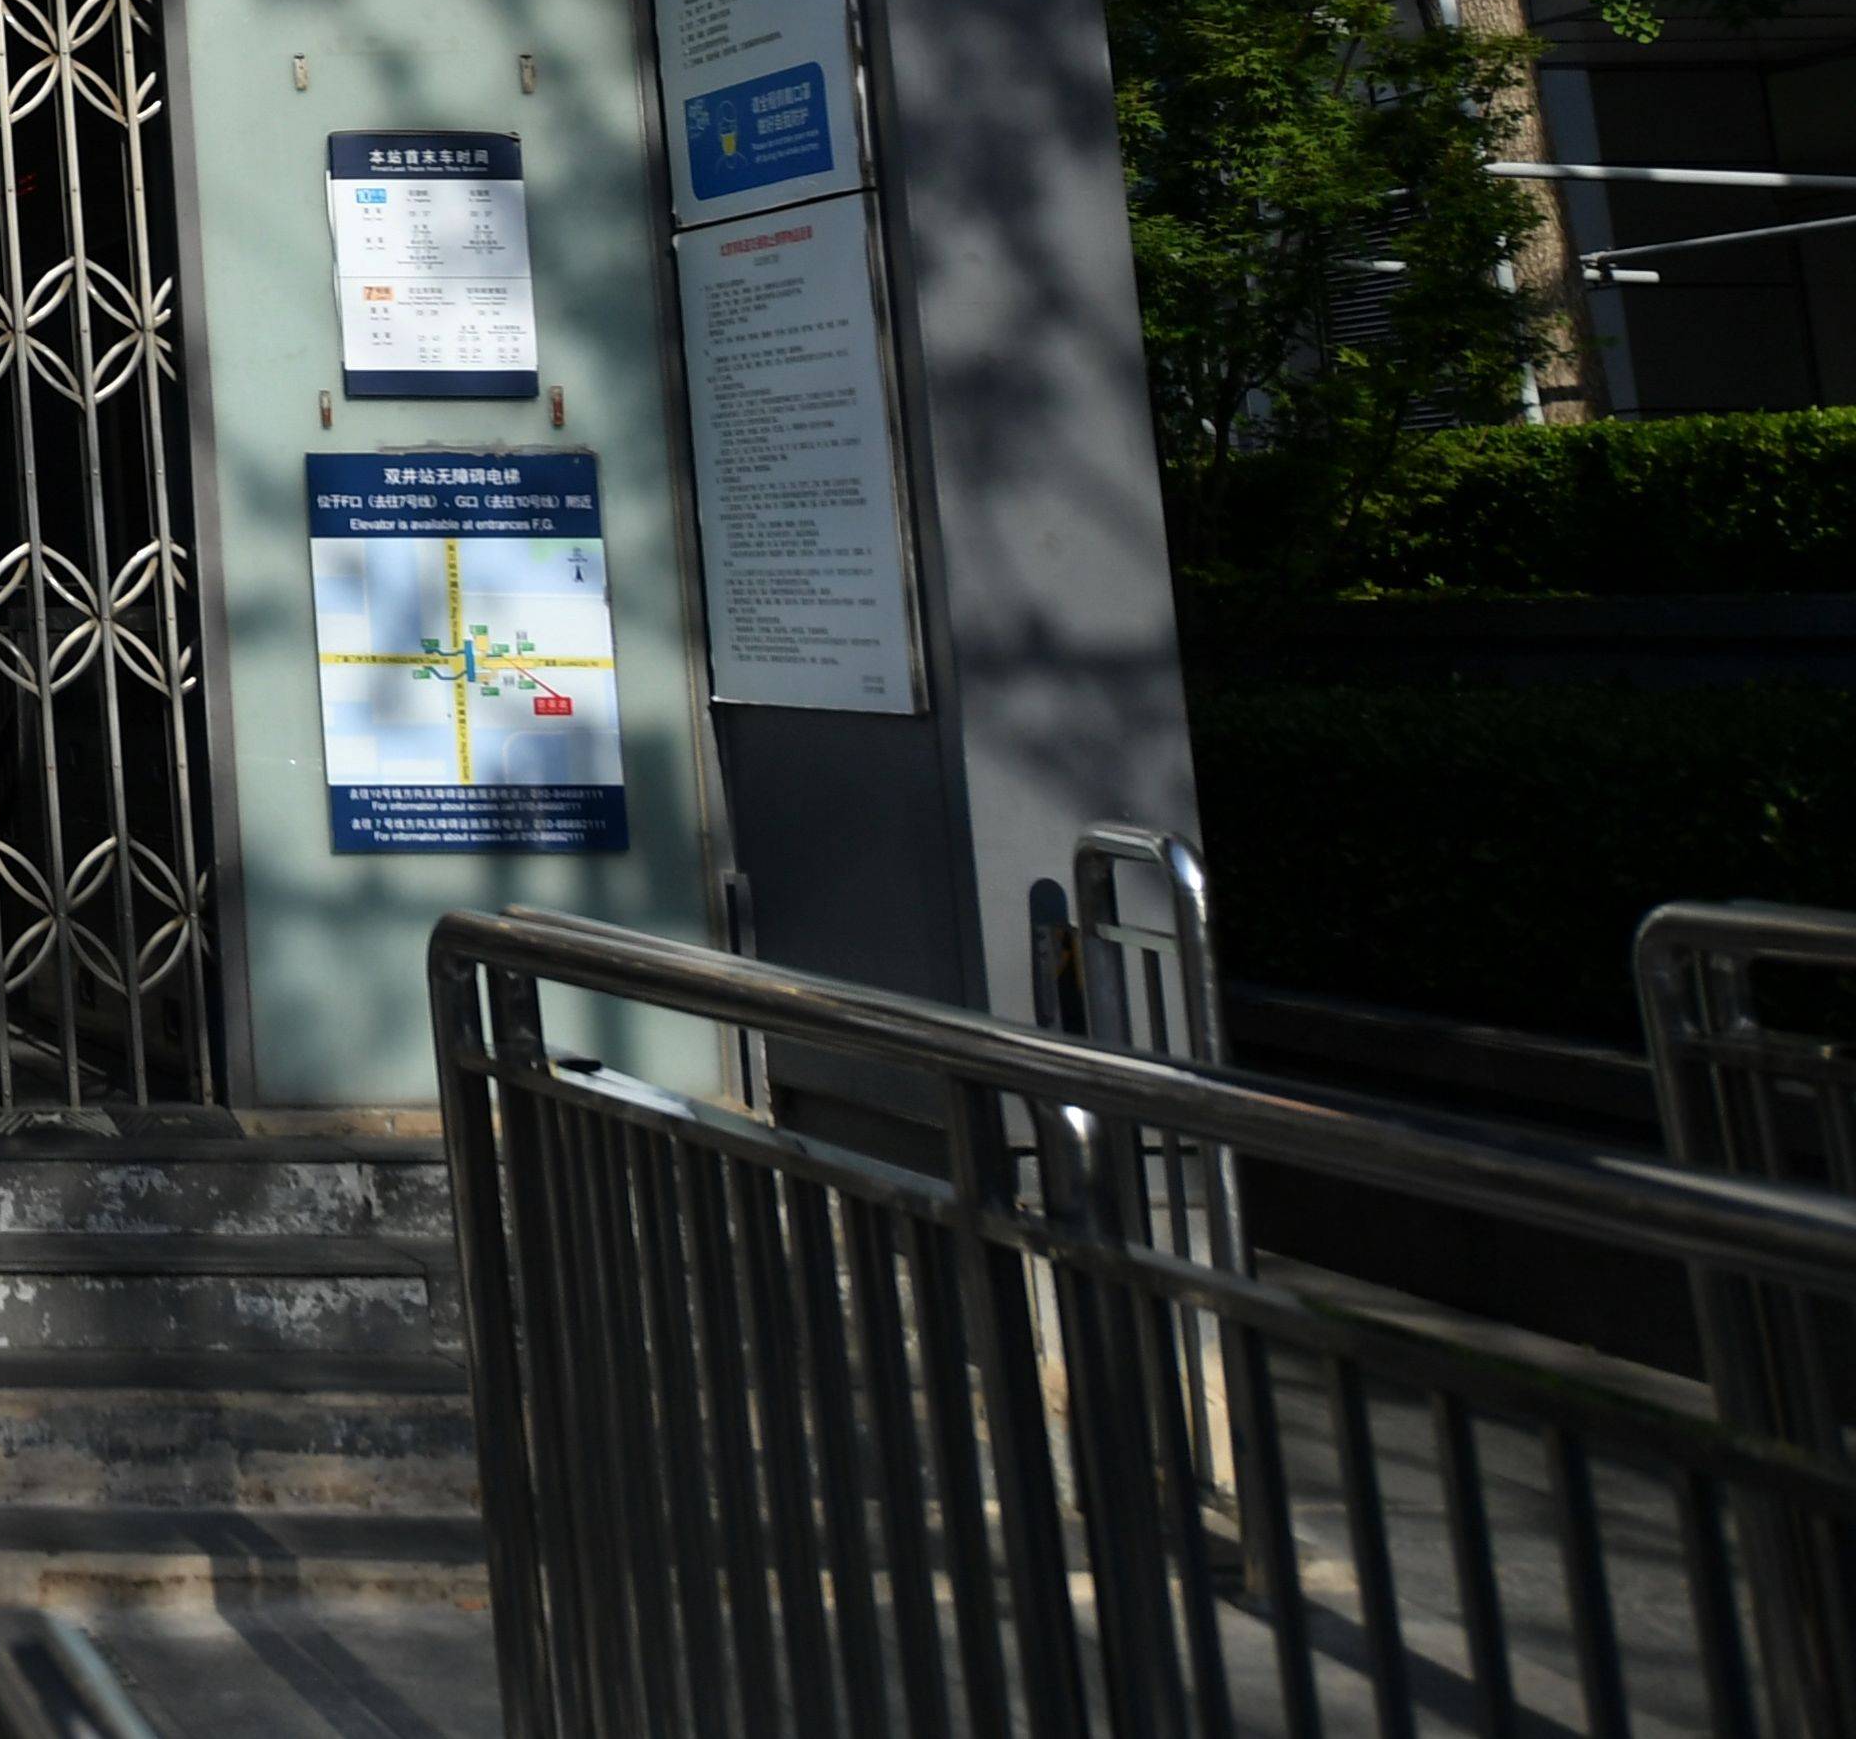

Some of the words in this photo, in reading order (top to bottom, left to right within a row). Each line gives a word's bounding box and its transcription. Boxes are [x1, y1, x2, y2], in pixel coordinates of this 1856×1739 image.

[383, 467, 522, 486] 双井站无障碍电梯
